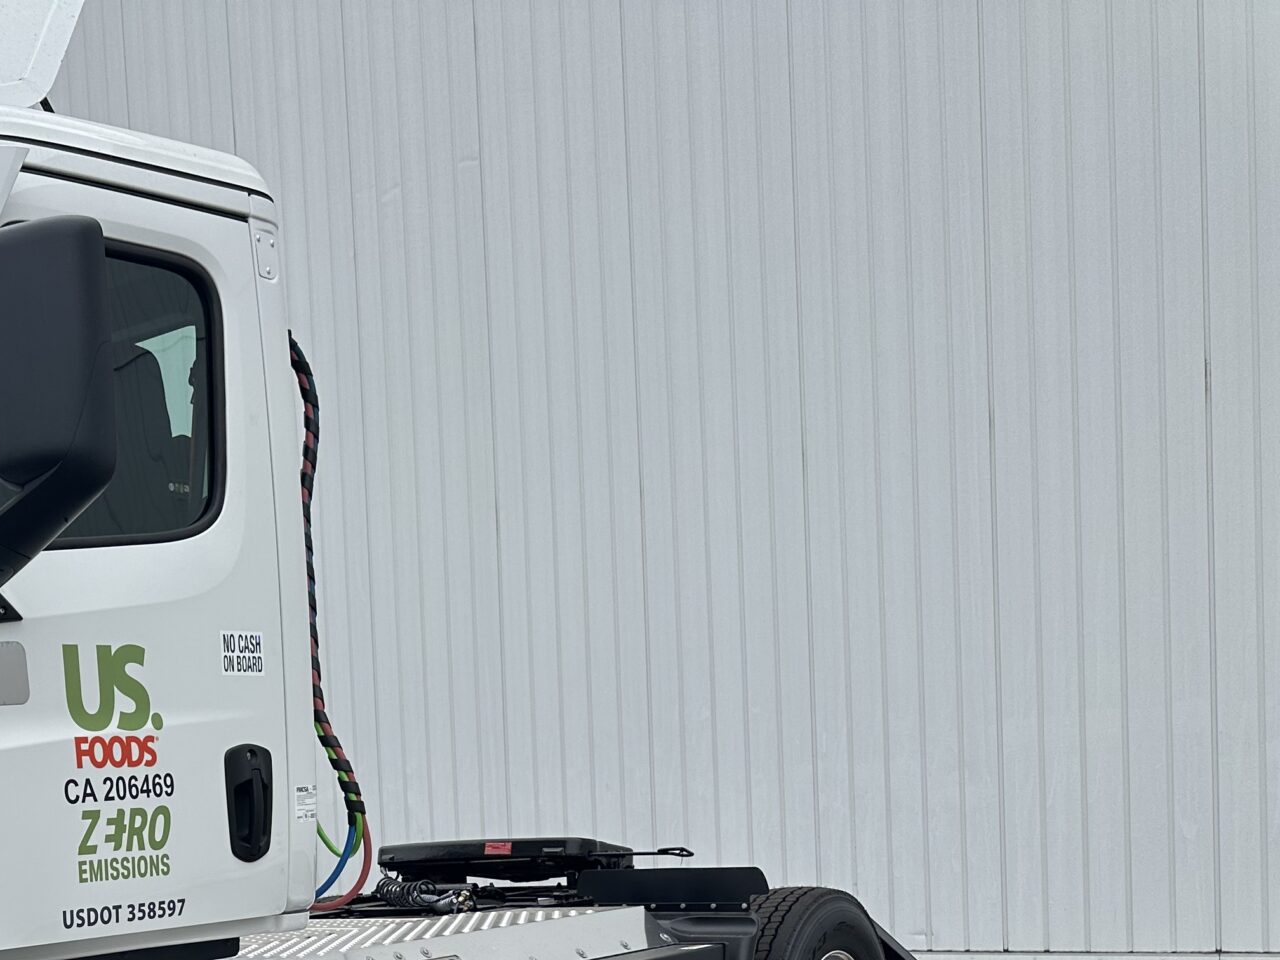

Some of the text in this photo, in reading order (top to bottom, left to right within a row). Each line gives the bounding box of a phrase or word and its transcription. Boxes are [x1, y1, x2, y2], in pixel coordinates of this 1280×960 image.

[222, 633, 261, 654] NO CASH
[223, 654, 263, 673] ON BOARD
[62, 643, 164, 732] US.
[74, 735, 159, 769] FOODS
[64, 772, 175, 805] CA 206469
[77, 804, 171, 856] ZERO
[77, 853, 171, 884] EMISSIONS
[62, 898, 186, 930] USDOT 358597
